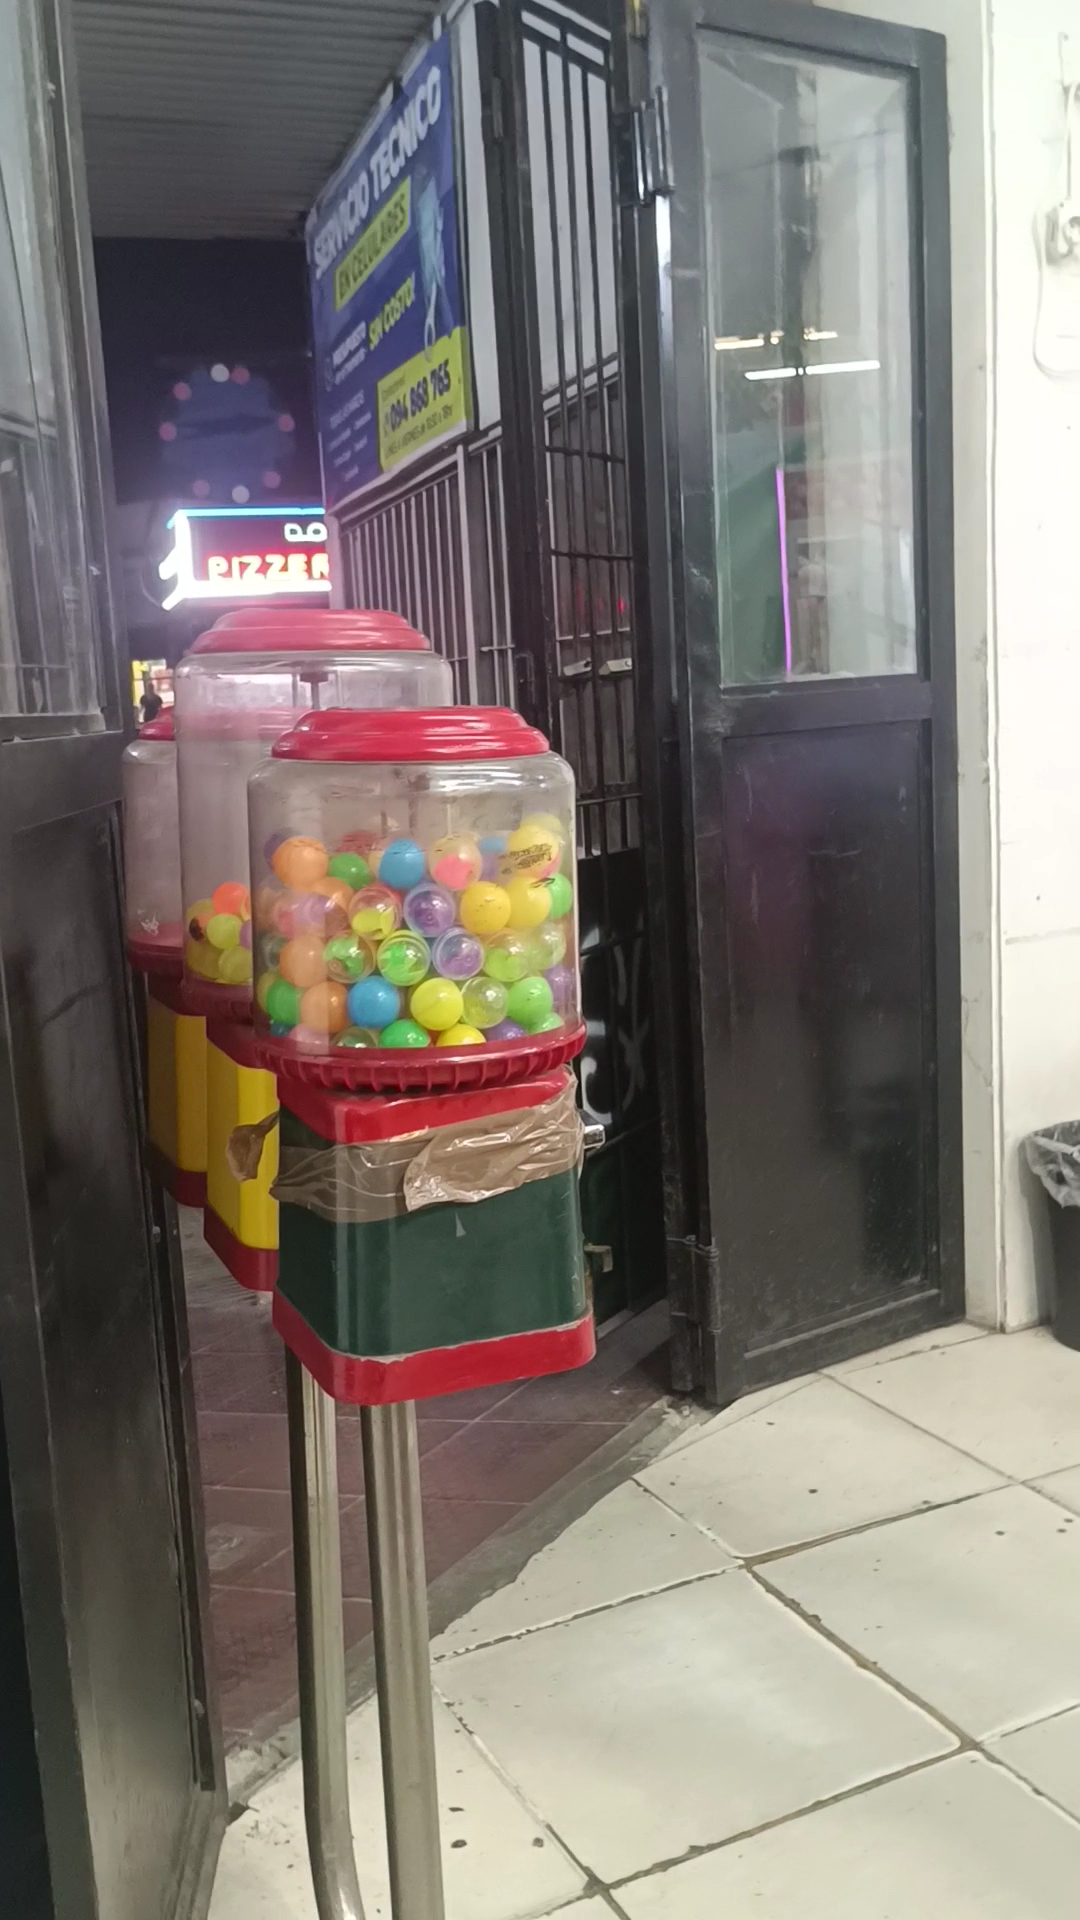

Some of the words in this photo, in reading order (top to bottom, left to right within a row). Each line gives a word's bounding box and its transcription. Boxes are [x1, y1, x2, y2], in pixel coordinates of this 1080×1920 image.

[313, 170, 369, 280] SERVICIO
[370, 65, 441, 201] TECNICO
[339, 263, 351, 301] EN
[350, 191, 406, 285] CELULARES
[368, 312, 384, 351] SIN
